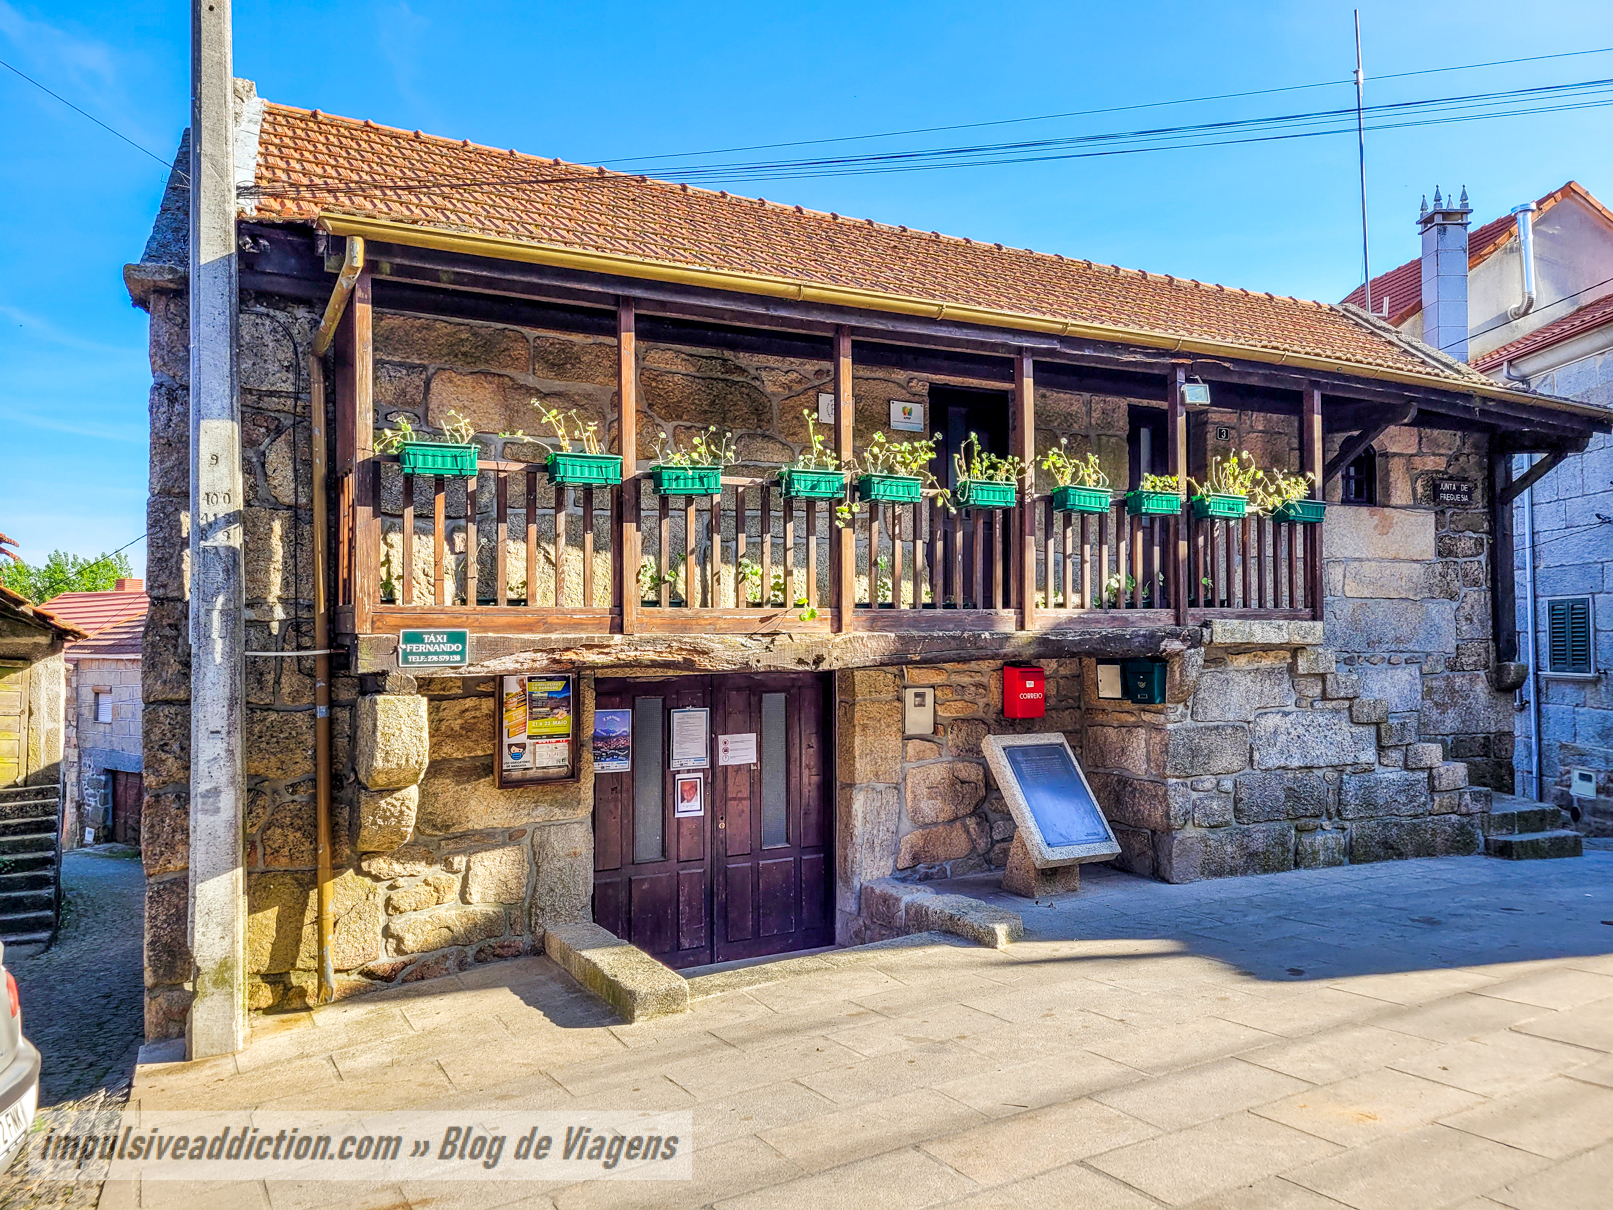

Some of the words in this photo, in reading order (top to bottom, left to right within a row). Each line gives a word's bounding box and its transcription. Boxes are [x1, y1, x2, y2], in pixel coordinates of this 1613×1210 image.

[1439, 493, 1469, 501] FREGUESIA
[422, 633, 447, 643] TÁXI
[406, 643, 462, 652] FERNANDO
